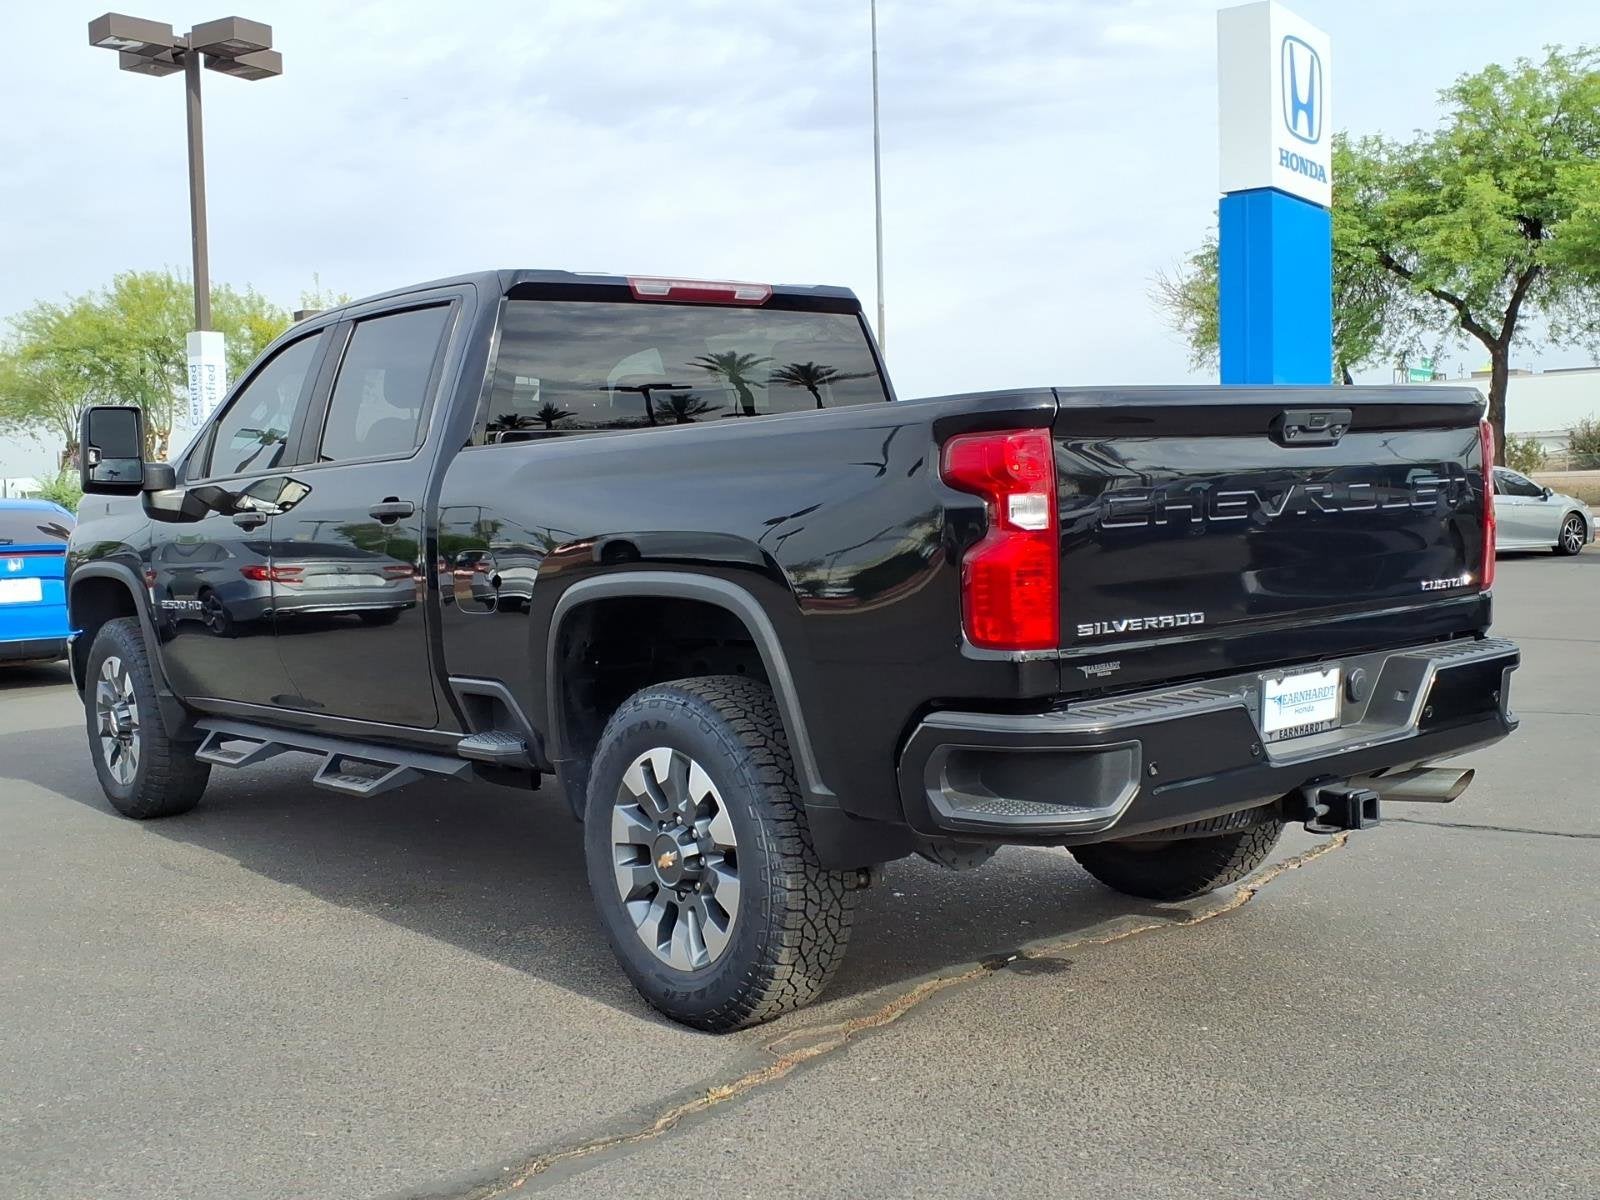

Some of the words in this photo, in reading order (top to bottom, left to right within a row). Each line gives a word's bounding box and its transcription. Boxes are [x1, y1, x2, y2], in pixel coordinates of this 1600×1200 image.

[1278, 146, 1328, 185] HONDA
[189, 364, 199, 426] Certified
[204, 364, 217, 412] rtified
[1100, 471, 1466, 528] CHEVROLET
[1077, 612, 1205, 636] SILVERADO
[1281, 685, 1336, 706] EARNHARDT
[1279, 721, 1325, 739] EARNHARDT
